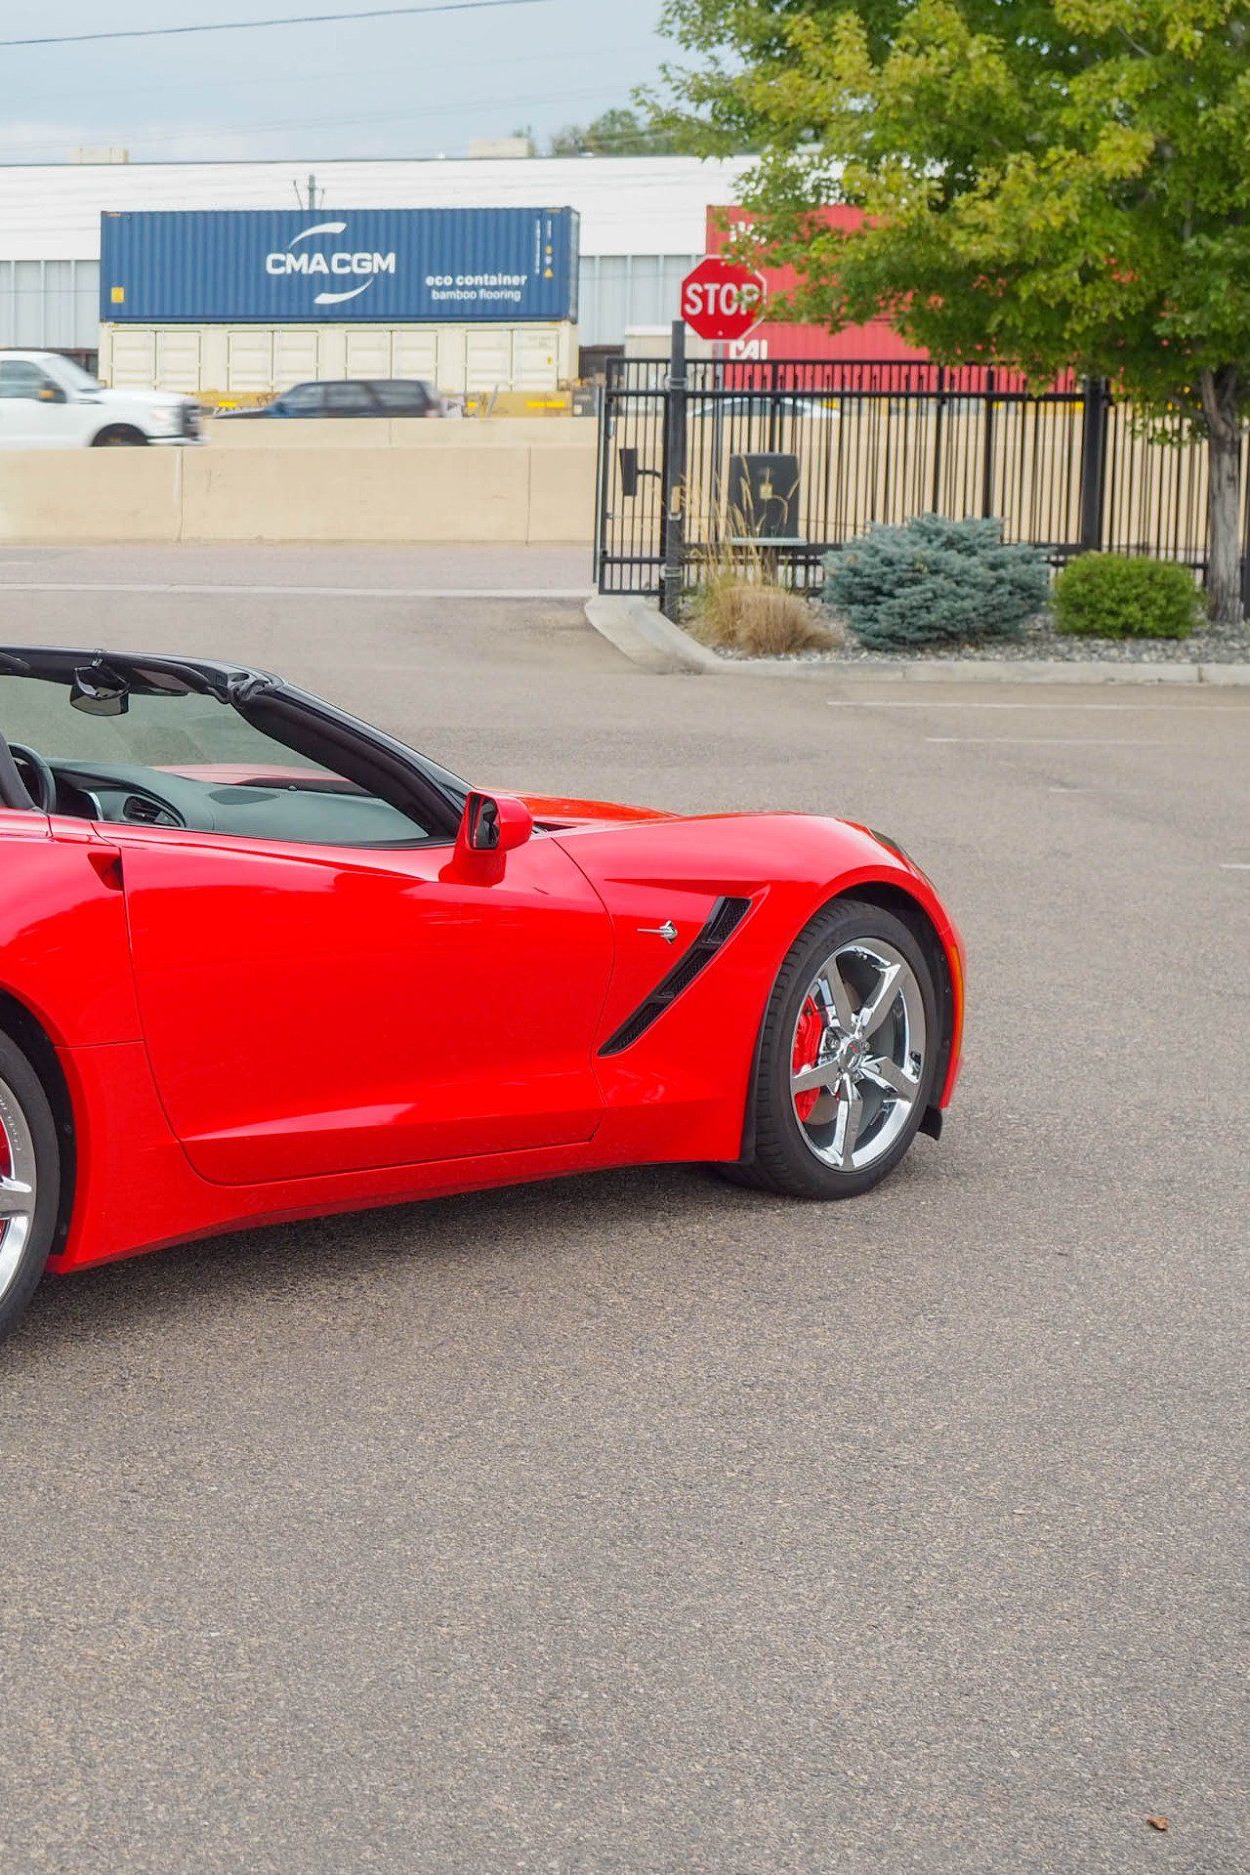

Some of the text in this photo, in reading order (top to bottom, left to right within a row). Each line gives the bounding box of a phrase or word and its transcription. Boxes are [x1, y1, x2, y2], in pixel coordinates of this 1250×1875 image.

[266, 252, 396, 274] CMA CGM
[425, 272, 528, 286] eco container
[431, 288, 522, 302] bamboo flooring
[684, 283, 761, 316] STOP
[730, 339, 768, 359] CAI
